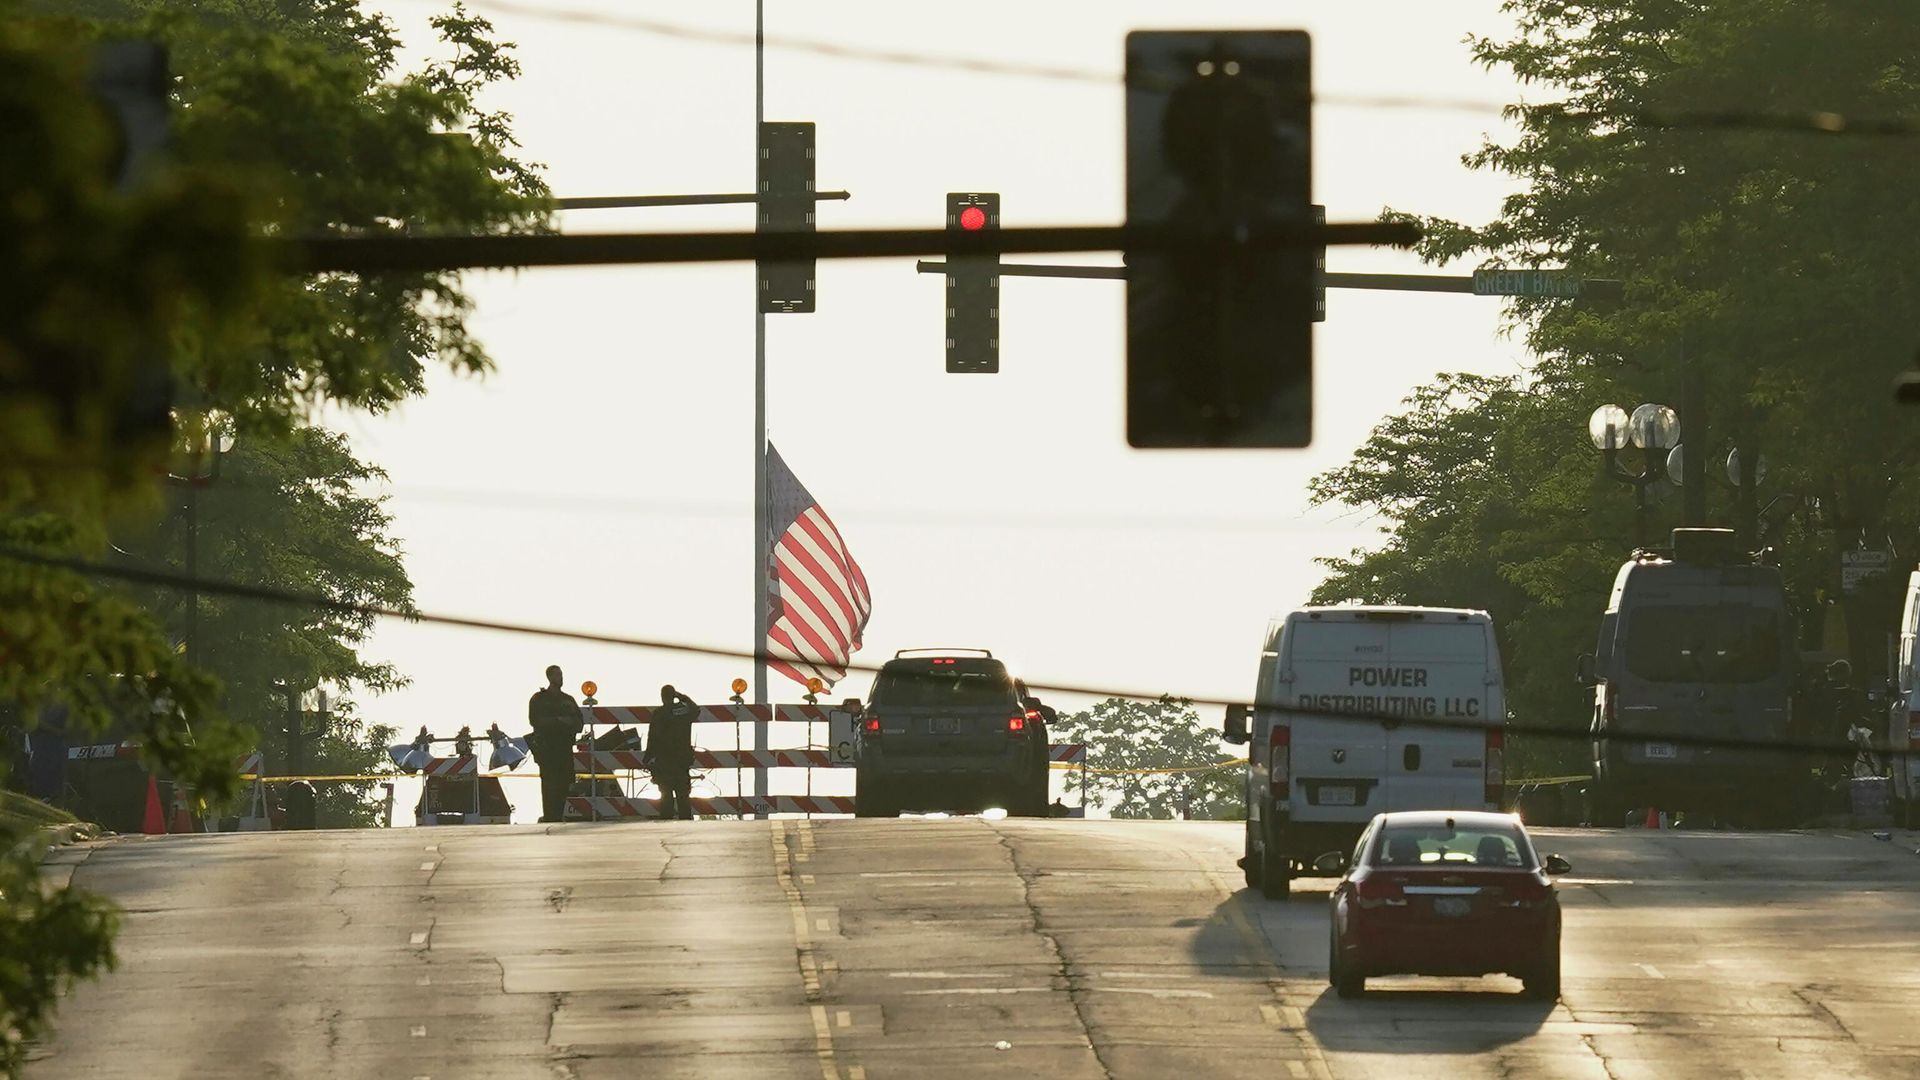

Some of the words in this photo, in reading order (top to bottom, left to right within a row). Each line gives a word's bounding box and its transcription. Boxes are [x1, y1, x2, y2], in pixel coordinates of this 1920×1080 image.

[1475, 271, 1524, 294] GREEN
[1350, 668, 1427, 687] POWER
[1300, 695, 1437, 718] DISTRIBUTING
[1445, 698, 1480, 717] LLC
